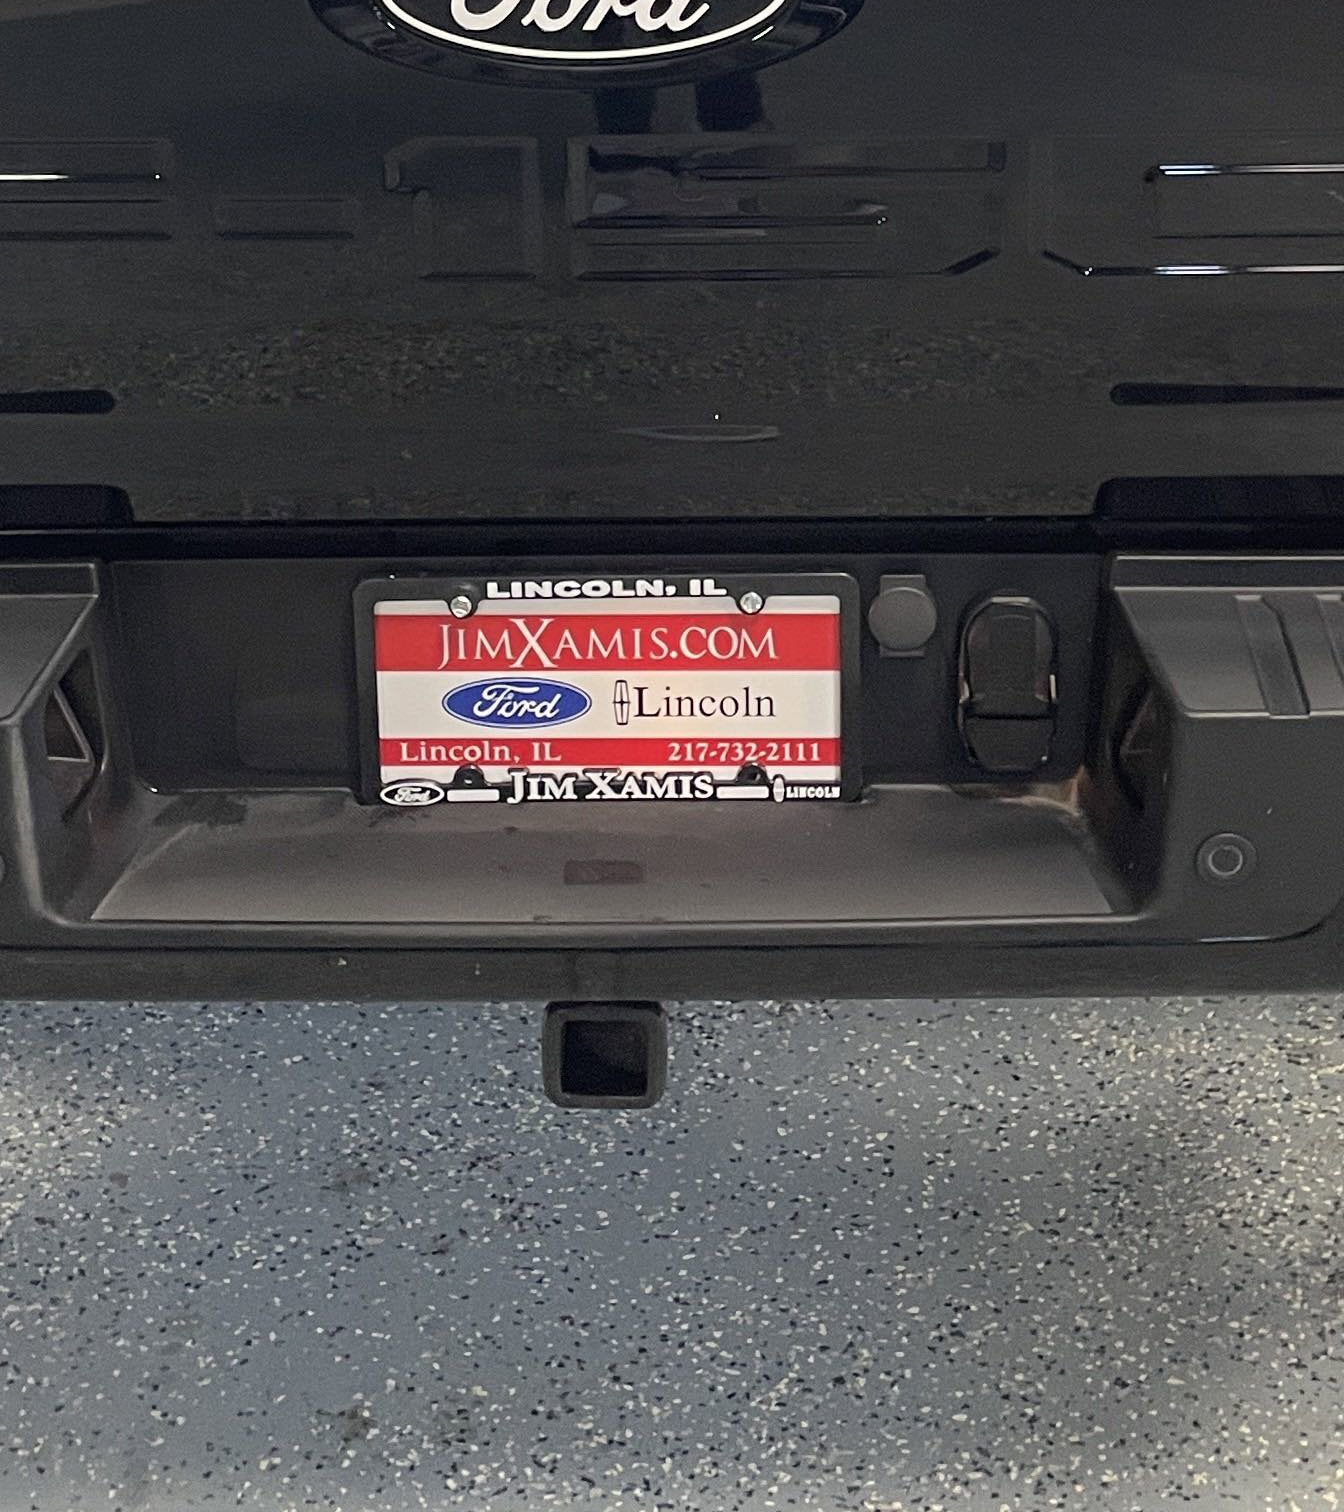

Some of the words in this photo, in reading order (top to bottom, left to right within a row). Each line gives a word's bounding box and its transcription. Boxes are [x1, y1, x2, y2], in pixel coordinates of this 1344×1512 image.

[486, 579, 676, 598] LINCOLN,
[688, 578, 728, 595] IL
[438, 617, 778, 670] JIMXAMIS.COM
[472, 680, 560, 719] Ford
[633, 686, 776, 718] Lincoln
[399, 741, 521, 764] Lincoln,
[532, 741, 562, 761] IL
[667, 741, 821, 763] 217-732-2111
[394, 787, 431, 804] Ford
[506, 770, 578, 805] JIM
[584, 770, 715, 800] XAMIS
[786, 785, 841, 799] LINCOLN
